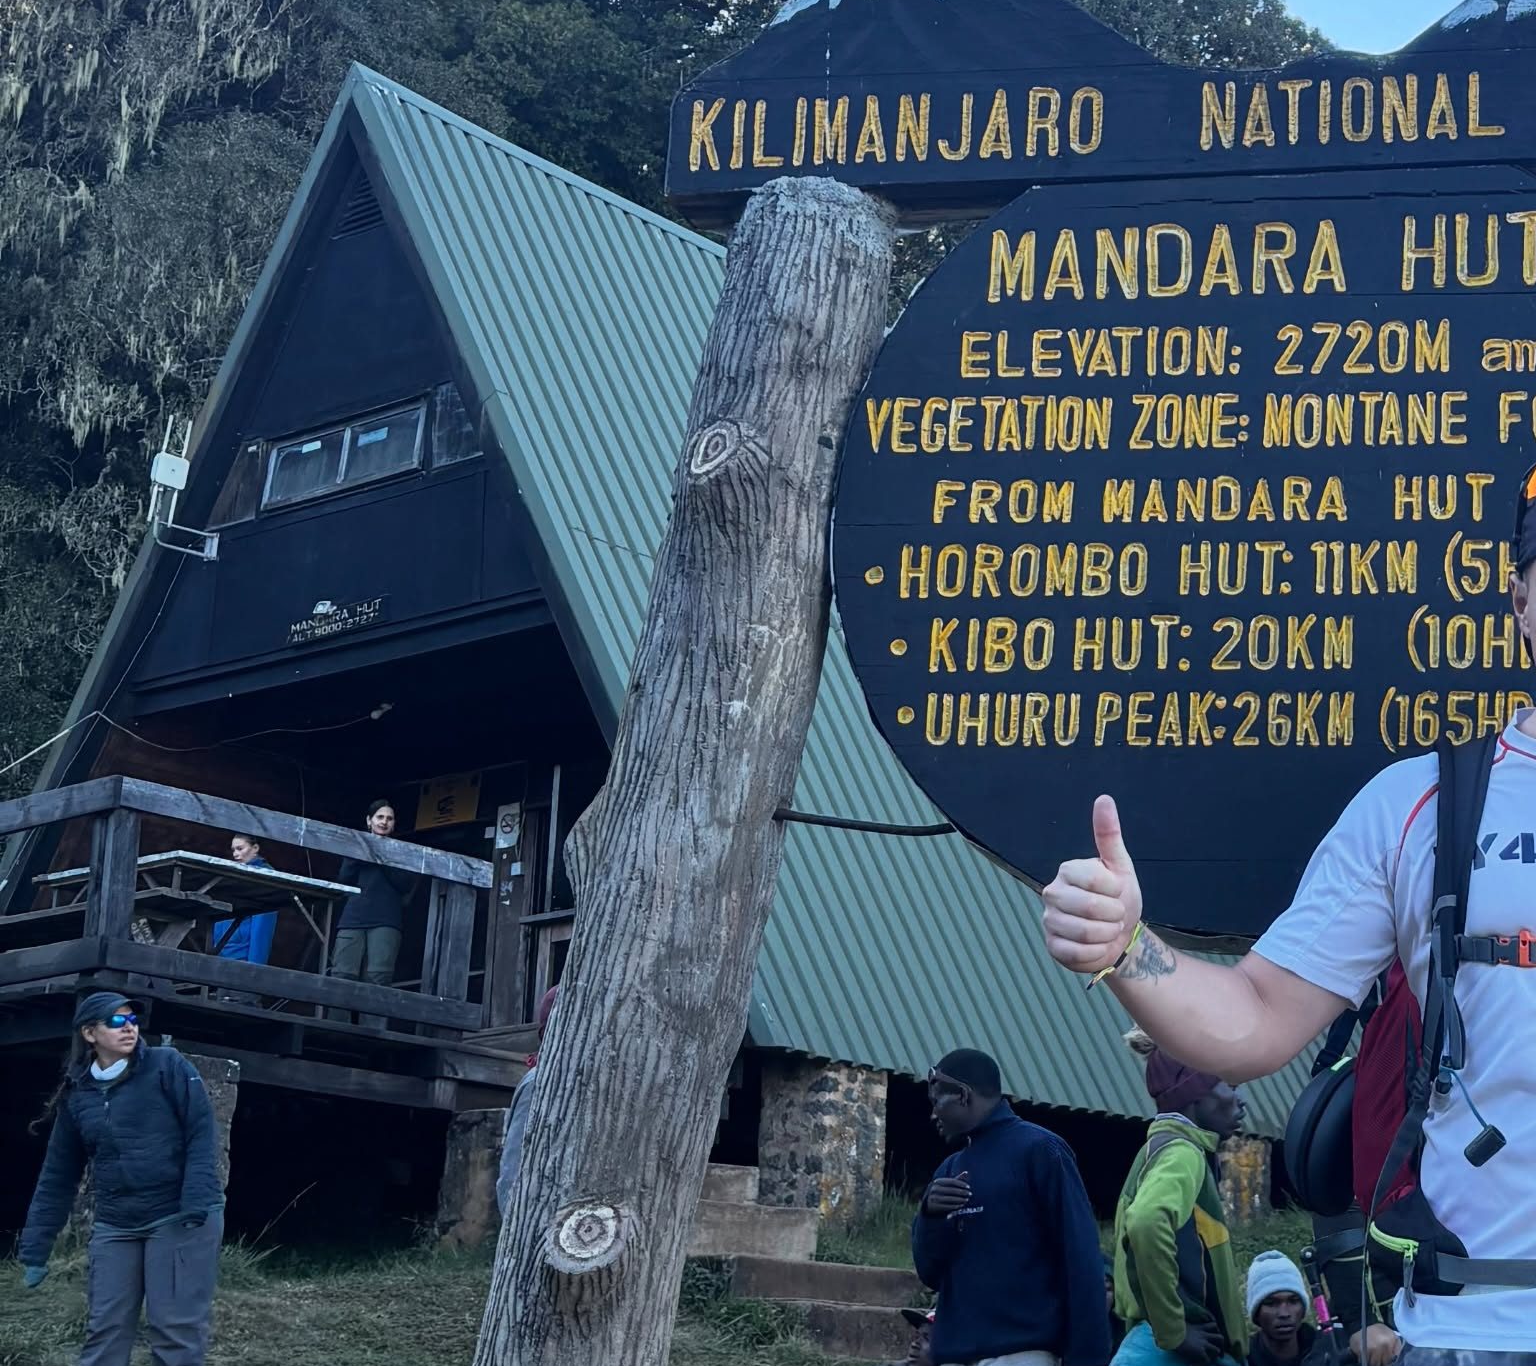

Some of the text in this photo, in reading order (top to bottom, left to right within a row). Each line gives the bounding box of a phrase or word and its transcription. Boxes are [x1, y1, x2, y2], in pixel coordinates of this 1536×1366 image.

[688, 86, 1102, 171] KILIMANJARO
[1199, 71, 1505, 149] NATIONAL
[987, 220, 1345, 303] MANDARA
[960, 326, 1241, 379] ELEVATION:
[1274, 320, 1450, 376] 2720M
[866, 395, 1113, 454] VEGETATION
[1128, 394, 1249, 450] ZONE:
[1262, 391, 1467, 449] MONTANE
[932, 473, 1494, 524] FROM MANDARA HUT
[899, 542, 1148, 599] HOROMBO
[1179, 541, 1293, 596] HUT:
[1310, 540, 1418, 596] 11KM
[356, 598, 382, 616] HUT
[928, 605, 1531, 674] KIBO HUT: 20KM (10H
[925, 692, 1080, 747] UHURU
